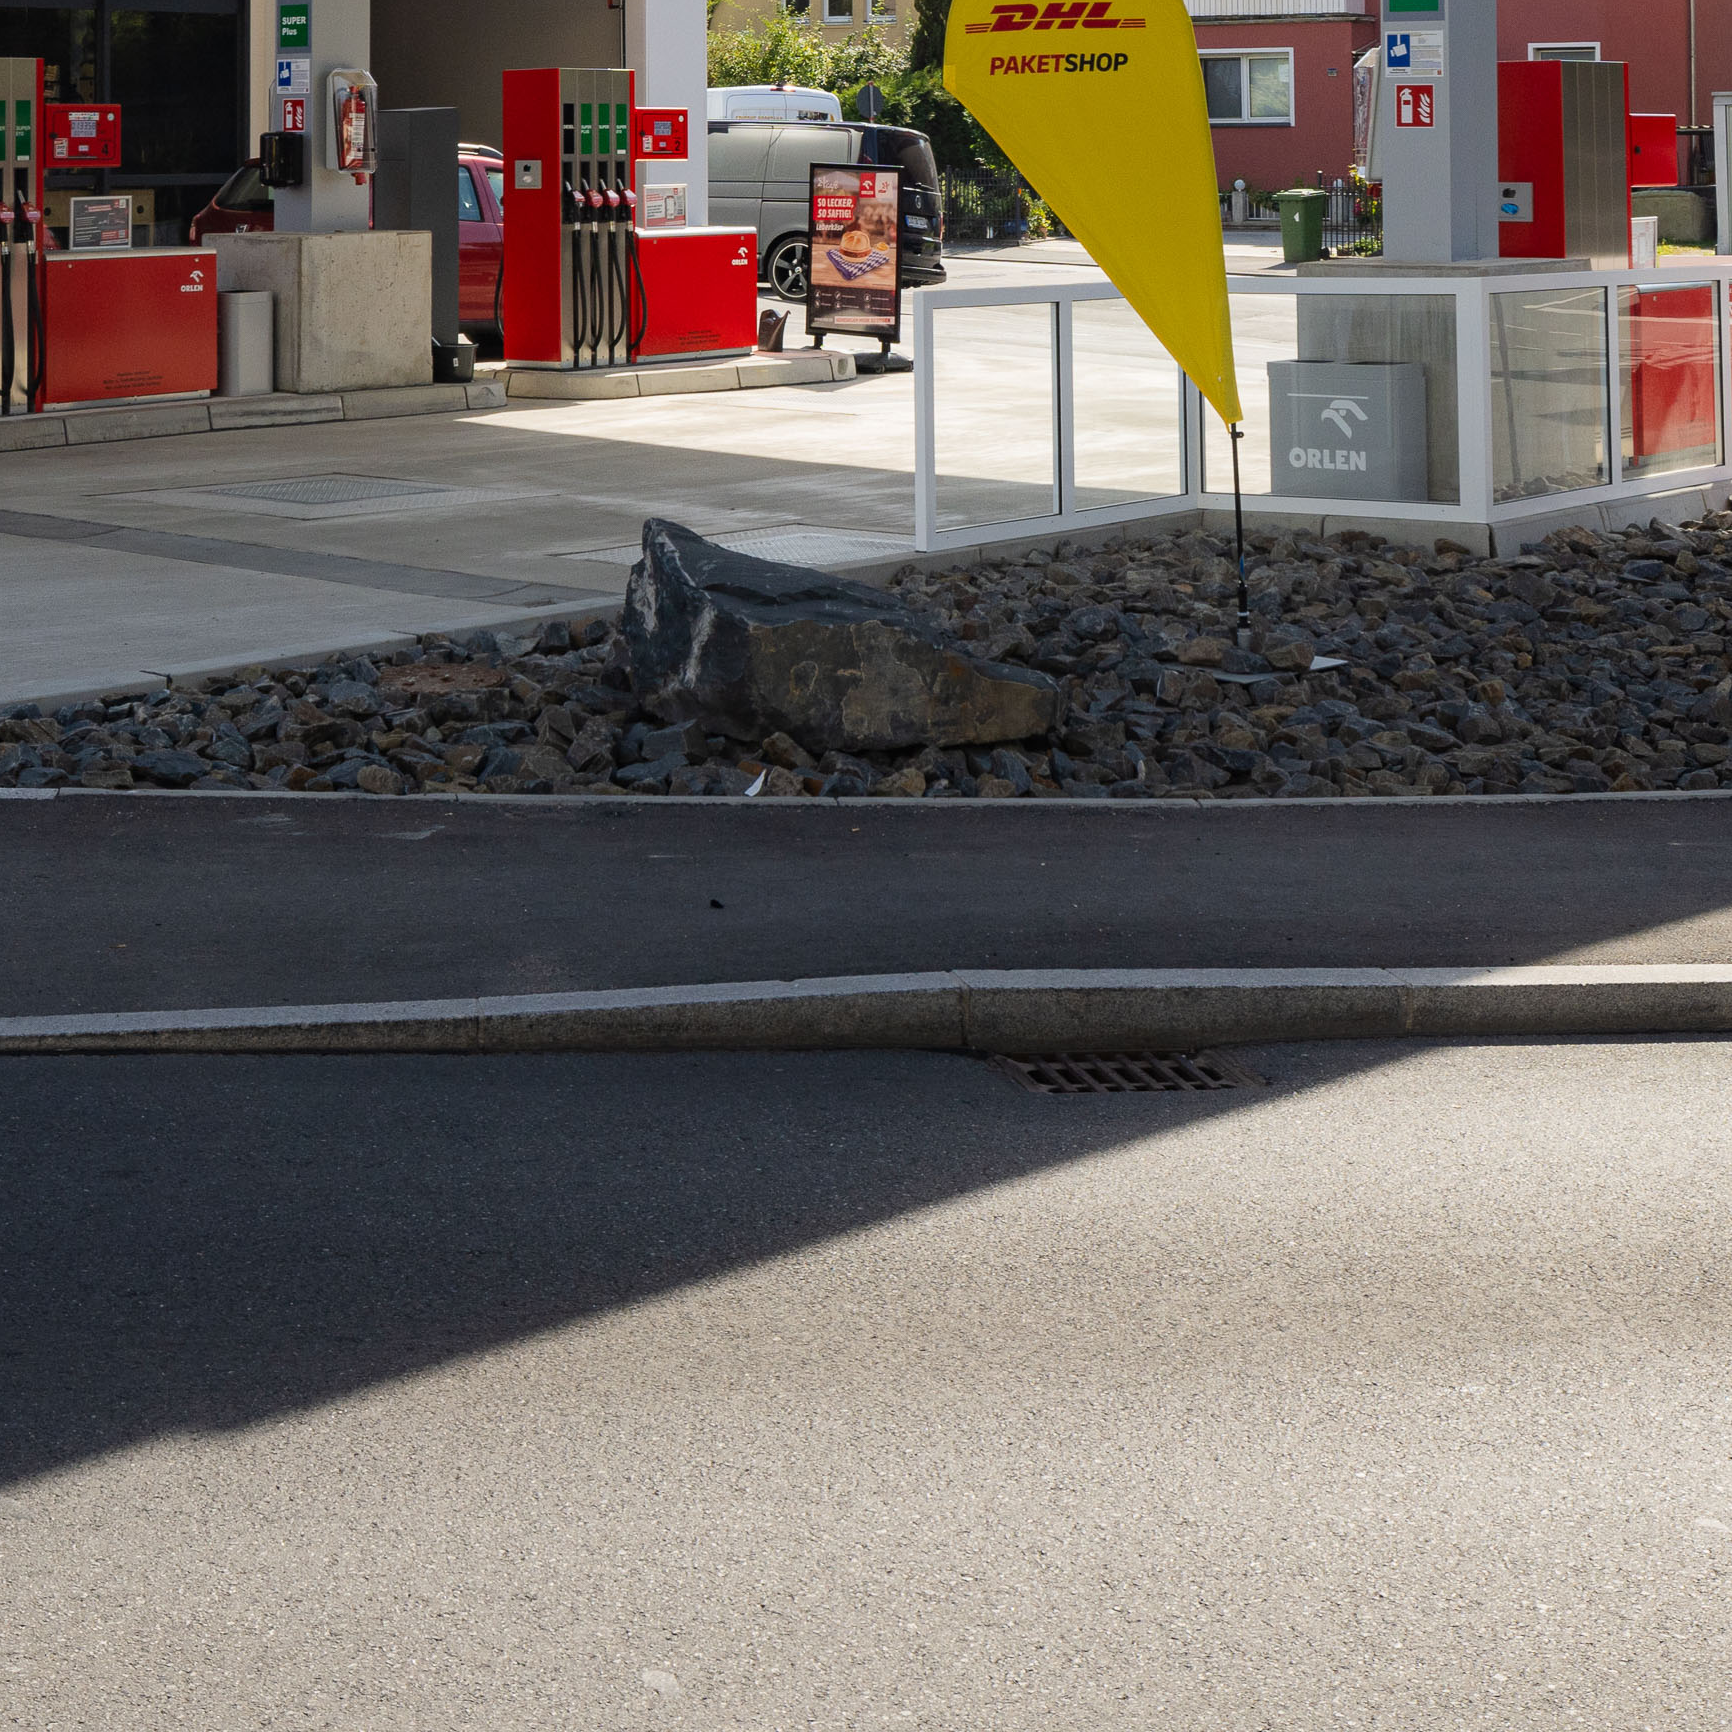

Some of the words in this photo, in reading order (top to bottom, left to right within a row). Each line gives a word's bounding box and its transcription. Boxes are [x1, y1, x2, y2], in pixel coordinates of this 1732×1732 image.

[282, 16, 307, 26] SUPER
[990, 2, 1123, 32] DHL
[282, 27, 297, 36] Plus
[989, 53, 1129, 76] PAKETSHOP
[817, 198, 826, 207] SO
[827, 198, 854, 208] LECKER,
[817, 209, 826, 218] SO
[180, 284, 204, 293] ORLEN
[1289, 446, 1367, 471] ORLEN
